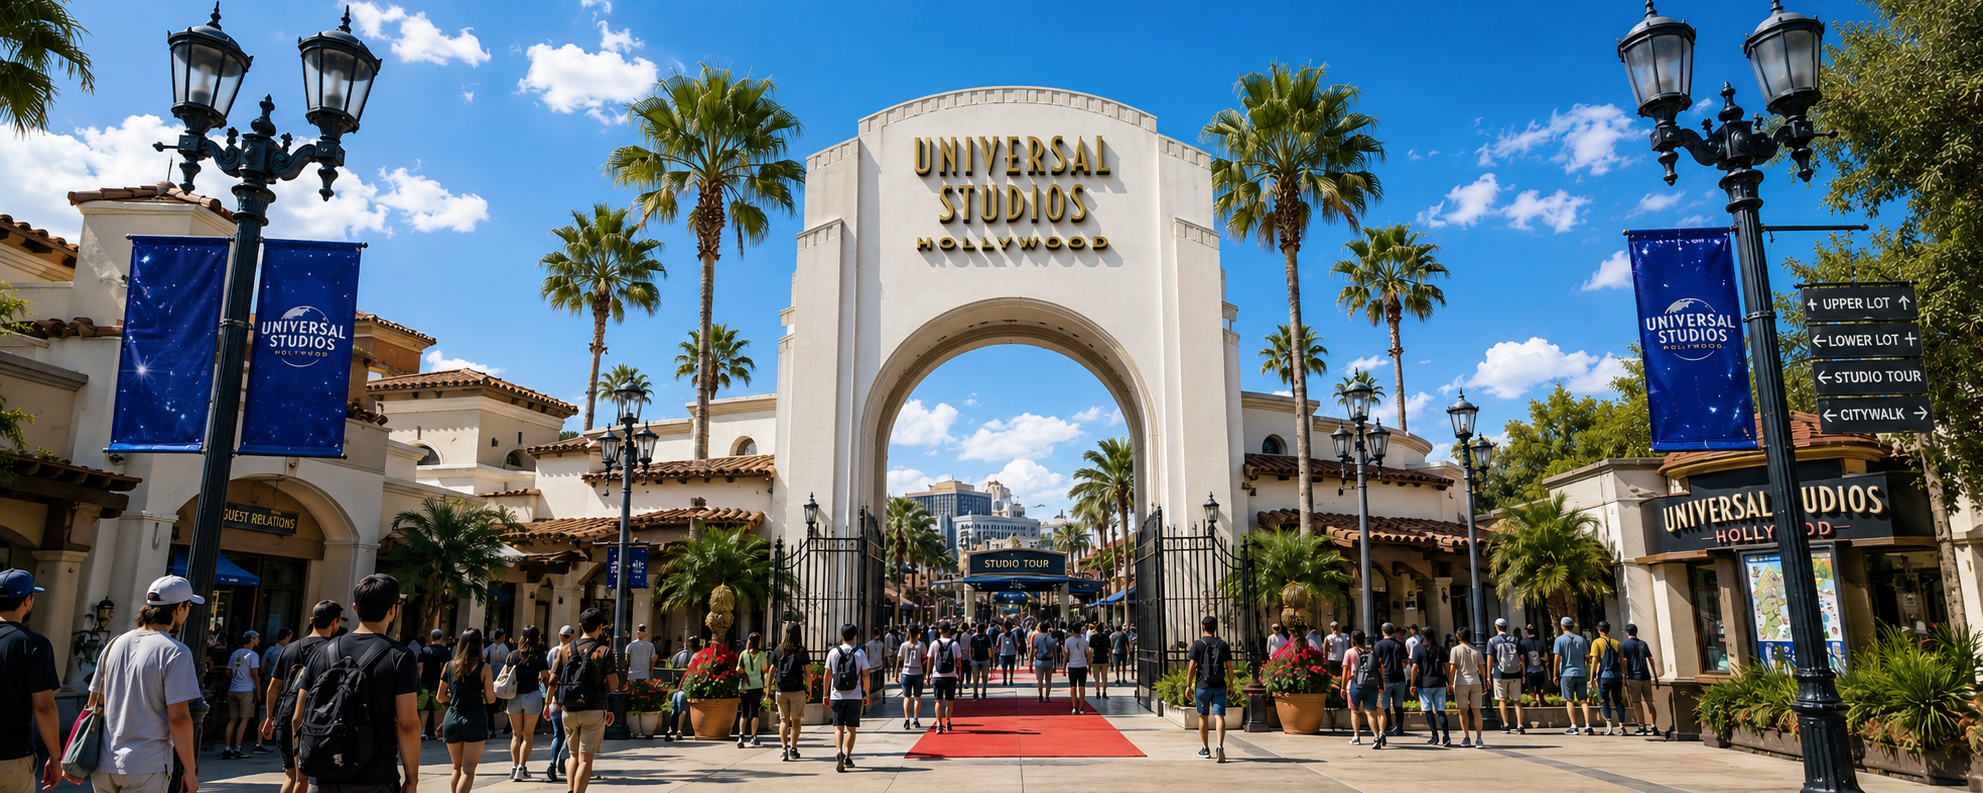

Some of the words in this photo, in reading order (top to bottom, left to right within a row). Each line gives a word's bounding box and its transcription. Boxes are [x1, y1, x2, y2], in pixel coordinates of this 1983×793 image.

[914, 135, 1110, 176] UNIVERSAL
[939, 183, 1087, 224] STUDIOS
[917, 236, 1109, 251] HOLLYWOOD
[1823, 297, 1863, 310] UPPER
[1866, 297, 1890, 309] LOT
[261, 320, 346, 339] UNIVERSAL
[1645, 313, 1736, 331] UNIVERSAL
[269, 334, 335, 351] STUDIOS
[1658, 328, 1728, 344] STUDIOS
[1828, 334, 1873, 347] LOWER
[1875, 334, 1899, 346] LOT
[1834, 370, 1882, 384] STUDIO
[1885, 370, 1922, 382] TOUR
[1840, 407, 1905, 421] CITYWALK
[1662, 490, 1774, 533] UNIVERSAL
[1801, 485, 1884, 515] UDIOS
[251, 513, 295, 530] RELATIONS
[1715, 521, 1832, 543] HOLLYOD
[984, 559, 1020, 568] STUDIO
[1023, 559, 1050, 568] TOUR
